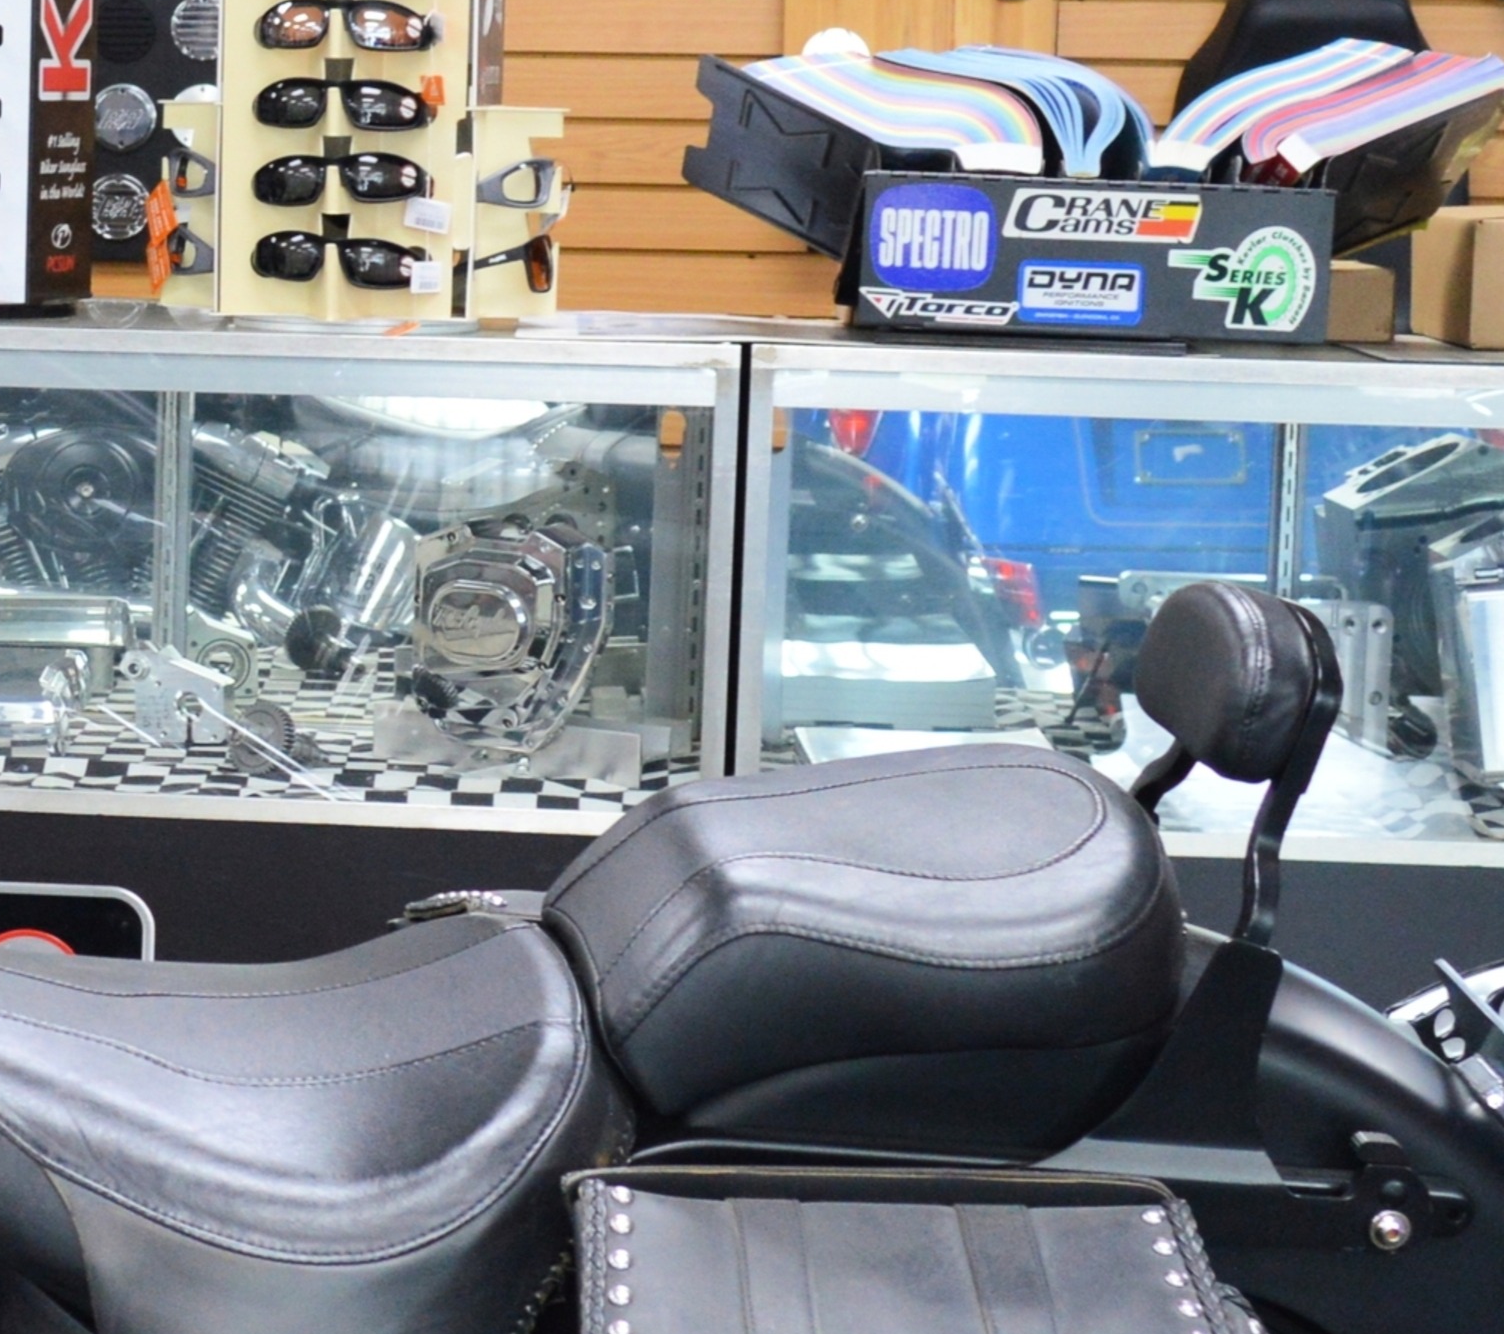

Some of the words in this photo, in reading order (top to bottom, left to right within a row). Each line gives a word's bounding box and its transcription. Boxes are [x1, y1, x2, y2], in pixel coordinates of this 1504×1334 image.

[878, 207, 990, 272] SPECTRO
[1203, 252, 1288, 286] SERIES
[1042, 291, 1120, 301] PERFORMANCE
[1230, 286, 1276, 327] K
